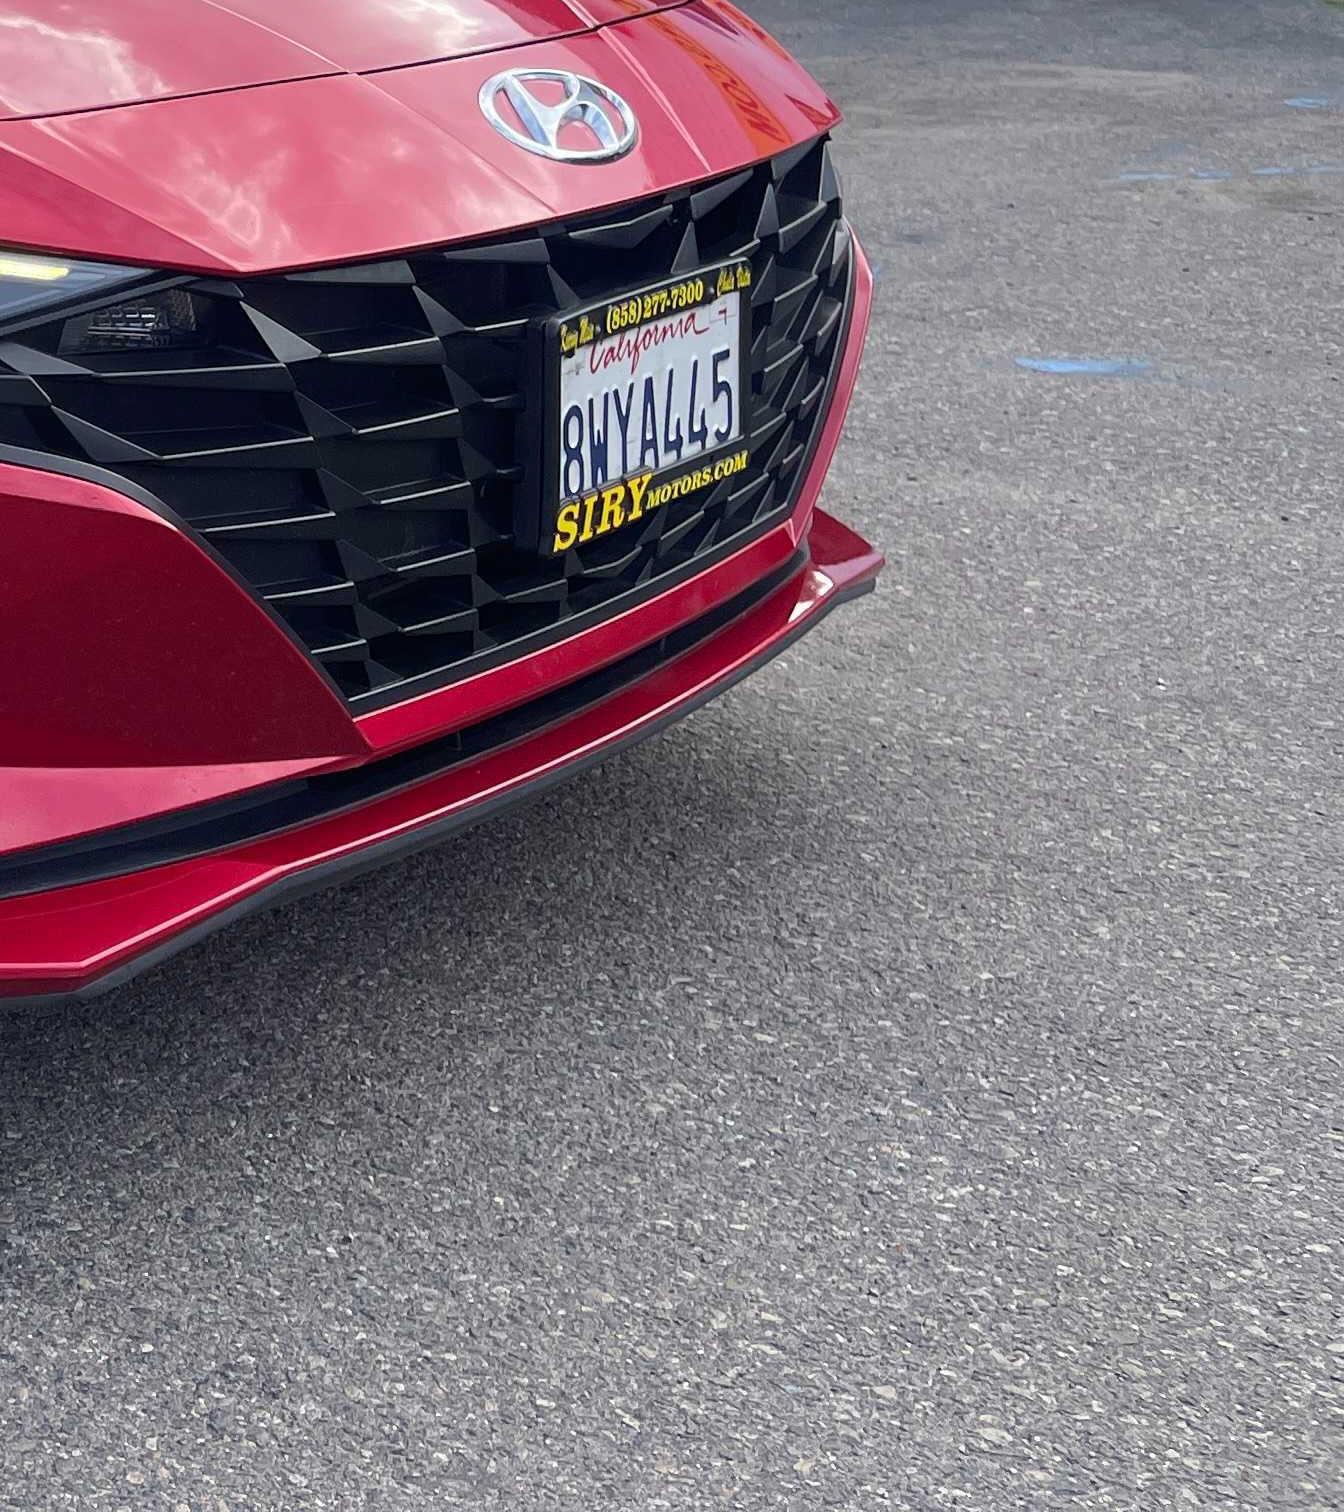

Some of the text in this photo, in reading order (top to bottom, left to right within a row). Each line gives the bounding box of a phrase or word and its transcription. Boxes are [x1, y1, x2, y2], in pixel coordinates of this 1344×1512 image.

[643, 277, 704, 318] 277-7300
[589, 311, 710, 375] California
[563, 348, 733, 498] 8WYA445
[553, 449, 749, 553] SIRY MOTORS.COM
